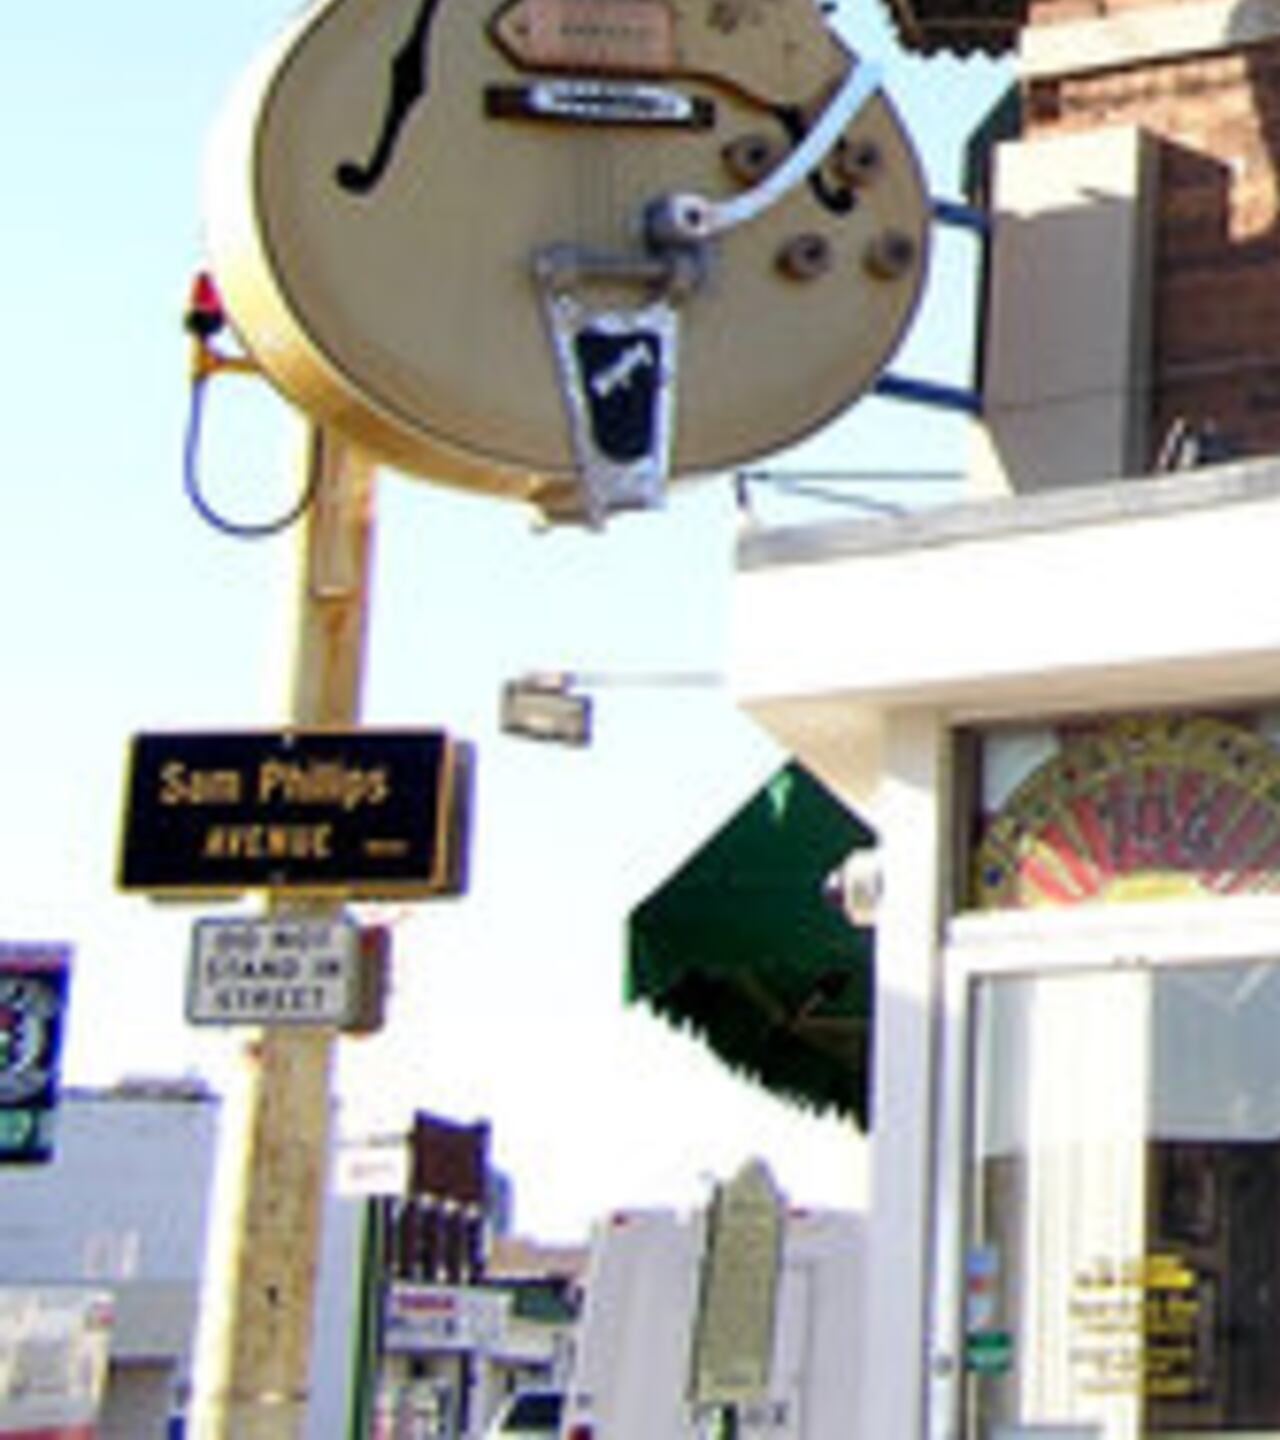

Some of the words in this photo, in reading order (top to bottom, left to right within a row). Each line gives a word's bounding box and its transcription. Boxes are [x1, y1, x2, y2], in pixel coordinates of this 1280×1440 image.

[160, 761, 240, 805] Sam
[258, 758, 390, 810] Phillips
[204, 823, 333, 858] AVENUE
[214, 927, 261, 954] DO
[271, 926, 332, 953] NOT
[206, 956, 301, 985] STAND
[312, 958, 344, 980] IN
[214, 987, 327, 1012] STREET
